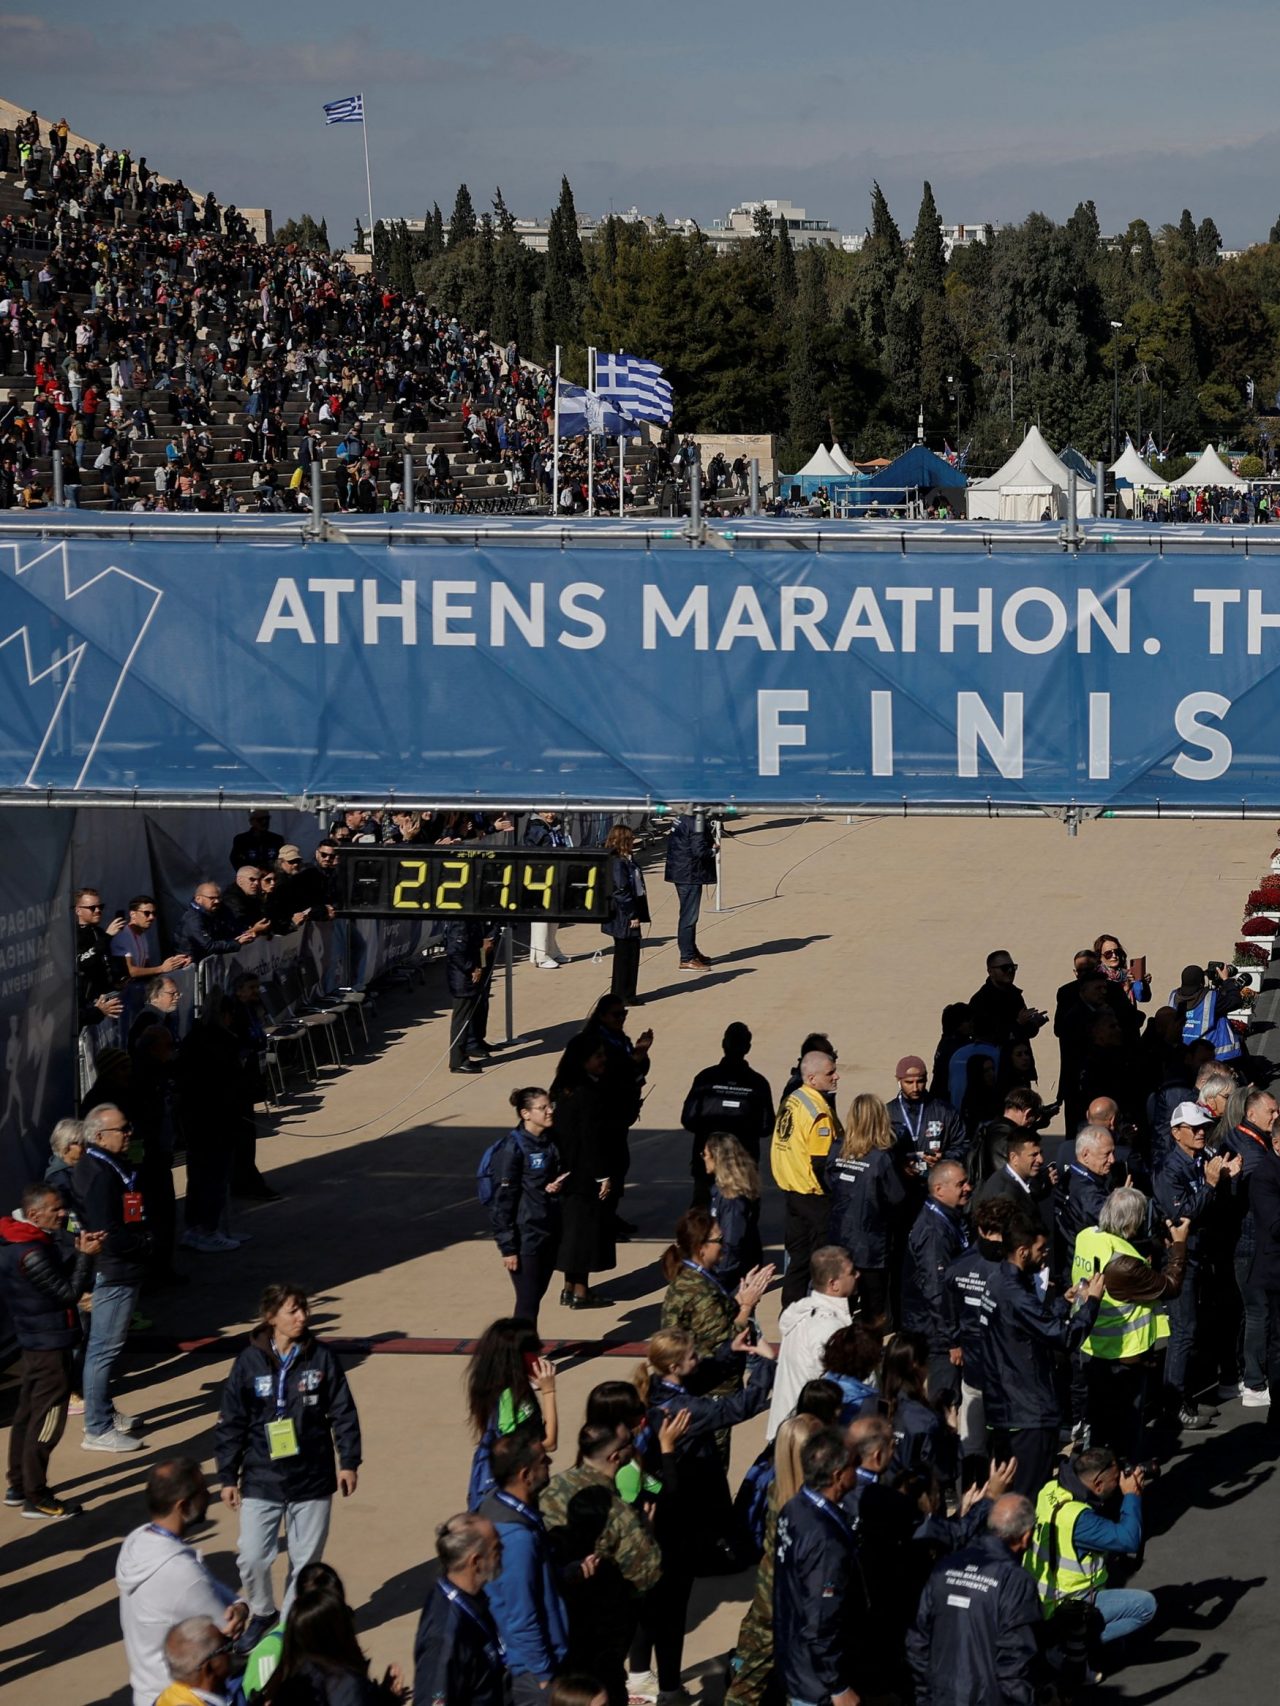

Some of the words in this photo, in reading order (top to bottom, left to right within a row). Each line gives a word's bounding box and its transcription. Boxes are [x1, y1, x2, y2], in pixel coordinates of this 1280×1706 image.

[255, 577, 606, 650] ATHENS
[643, 584, 1161, 655] MARATHON.
[393, 860, 596, 910] 2.21.41
[1075, 1255, 1092, 1273] OTO
[955, 1577, 990, 1593] AUTHENTIC
[963, 1571, 999, 1588] MARATHON
